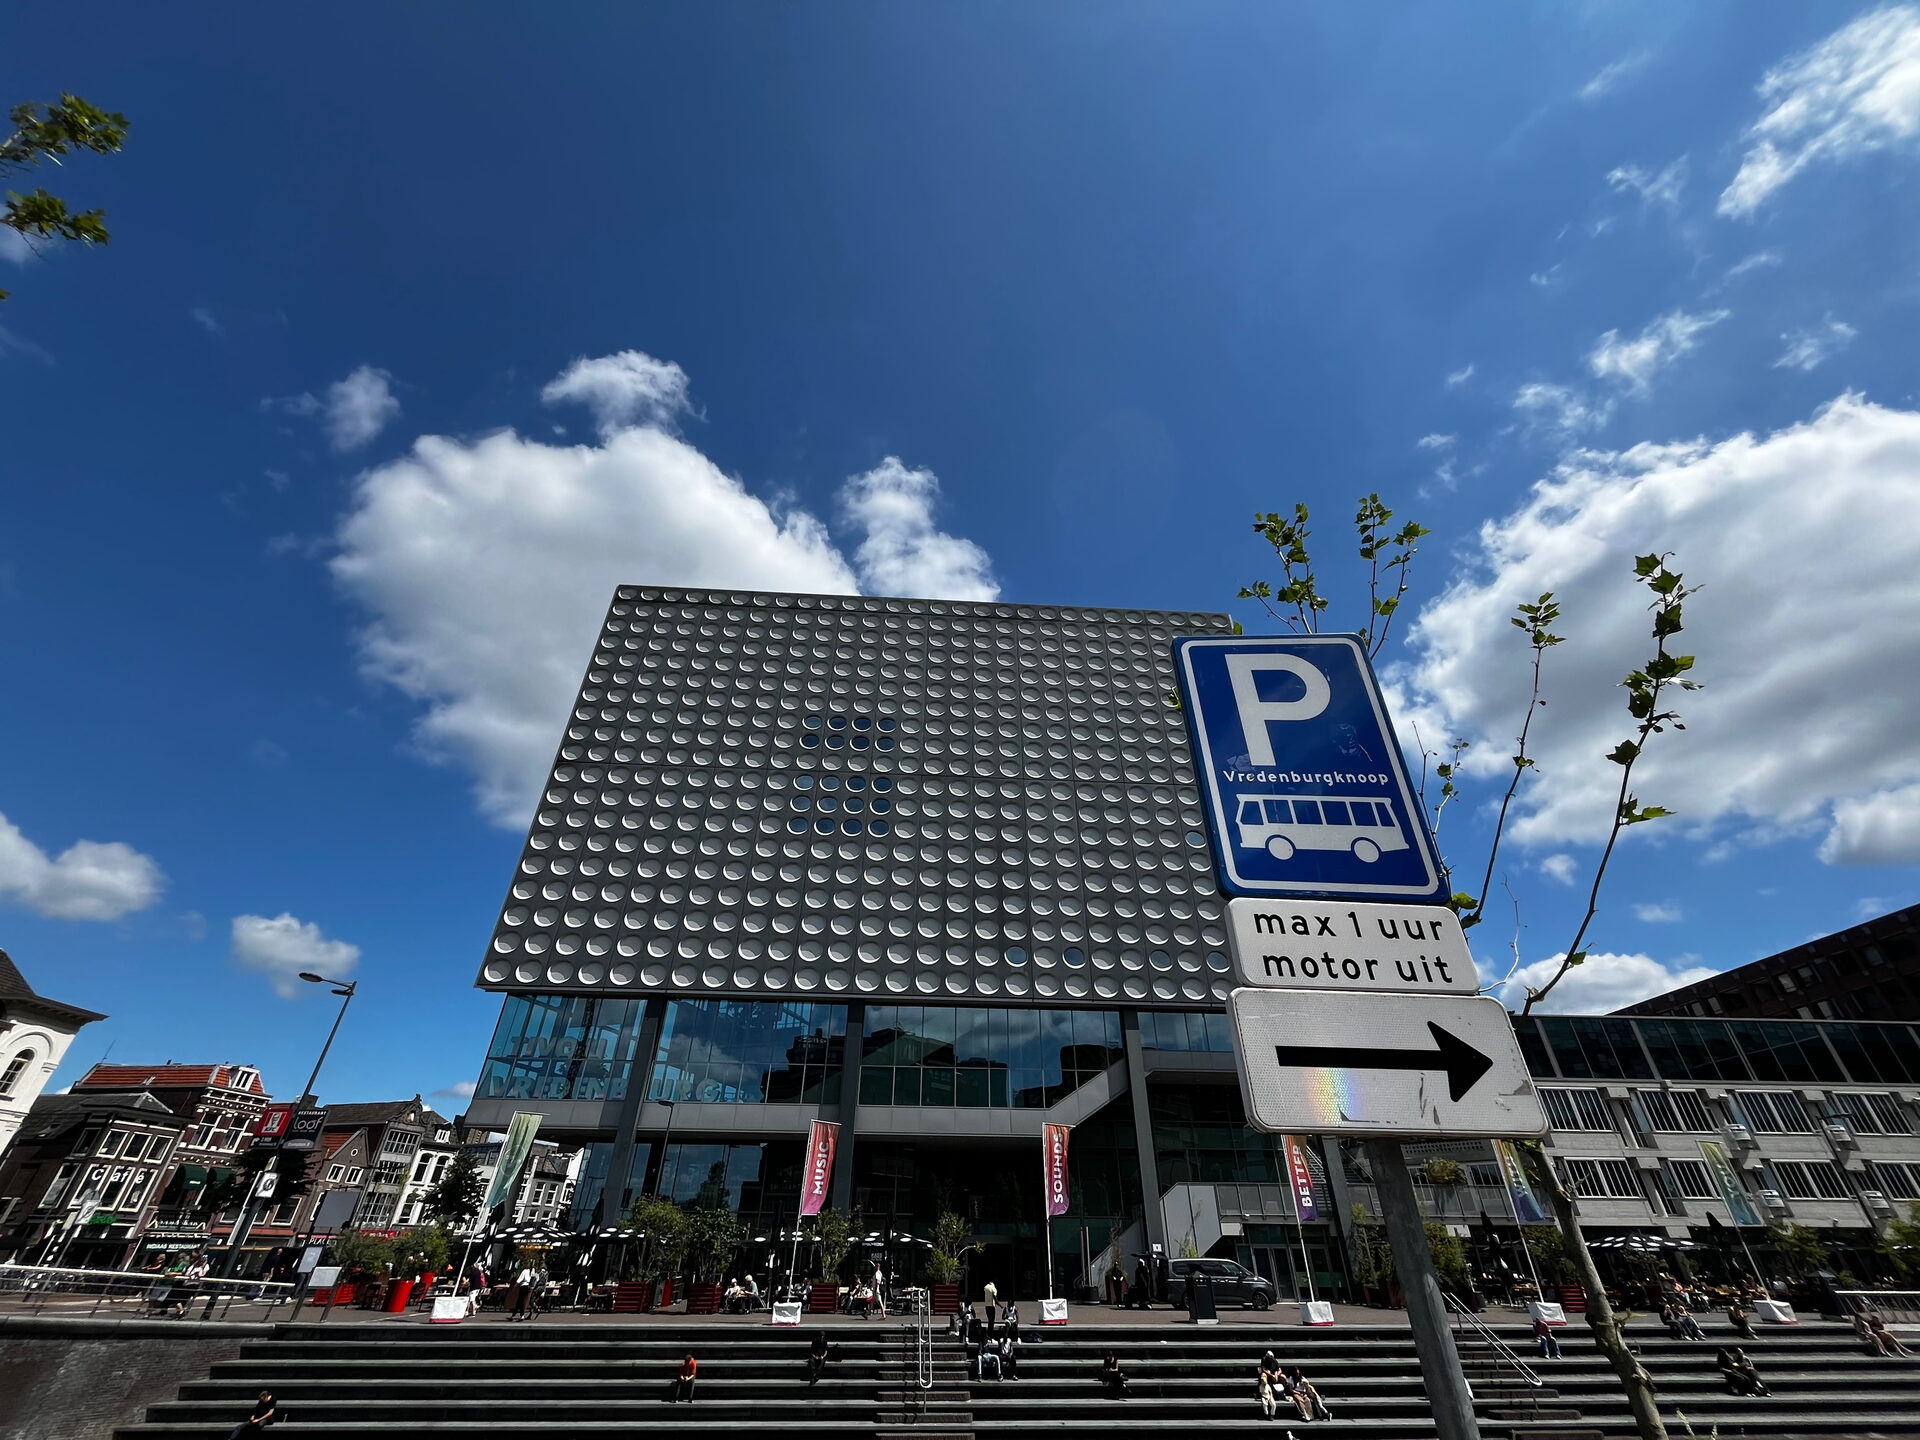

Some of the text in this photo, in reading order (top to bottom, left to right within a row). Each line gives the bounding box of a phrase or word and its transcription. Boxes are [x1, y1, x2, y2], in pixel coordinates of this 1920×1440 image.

[1224, 653, 1331, 766] P
[1223, 770, 1389, 787] Vredenburgknoop
[1253, 911, 1443, 941] max 1 uur
[1262, 952, 1453, 983] motor uit
[294, 1116, 324, 1129] loof
[91, 1168, 144, 1184] Café
[812, 1141, 829, 1195] MUSIC
[1053, 1132, 1064, 1204] SOUNDS
[1293, 1144, 1313, 1207] BETTER
